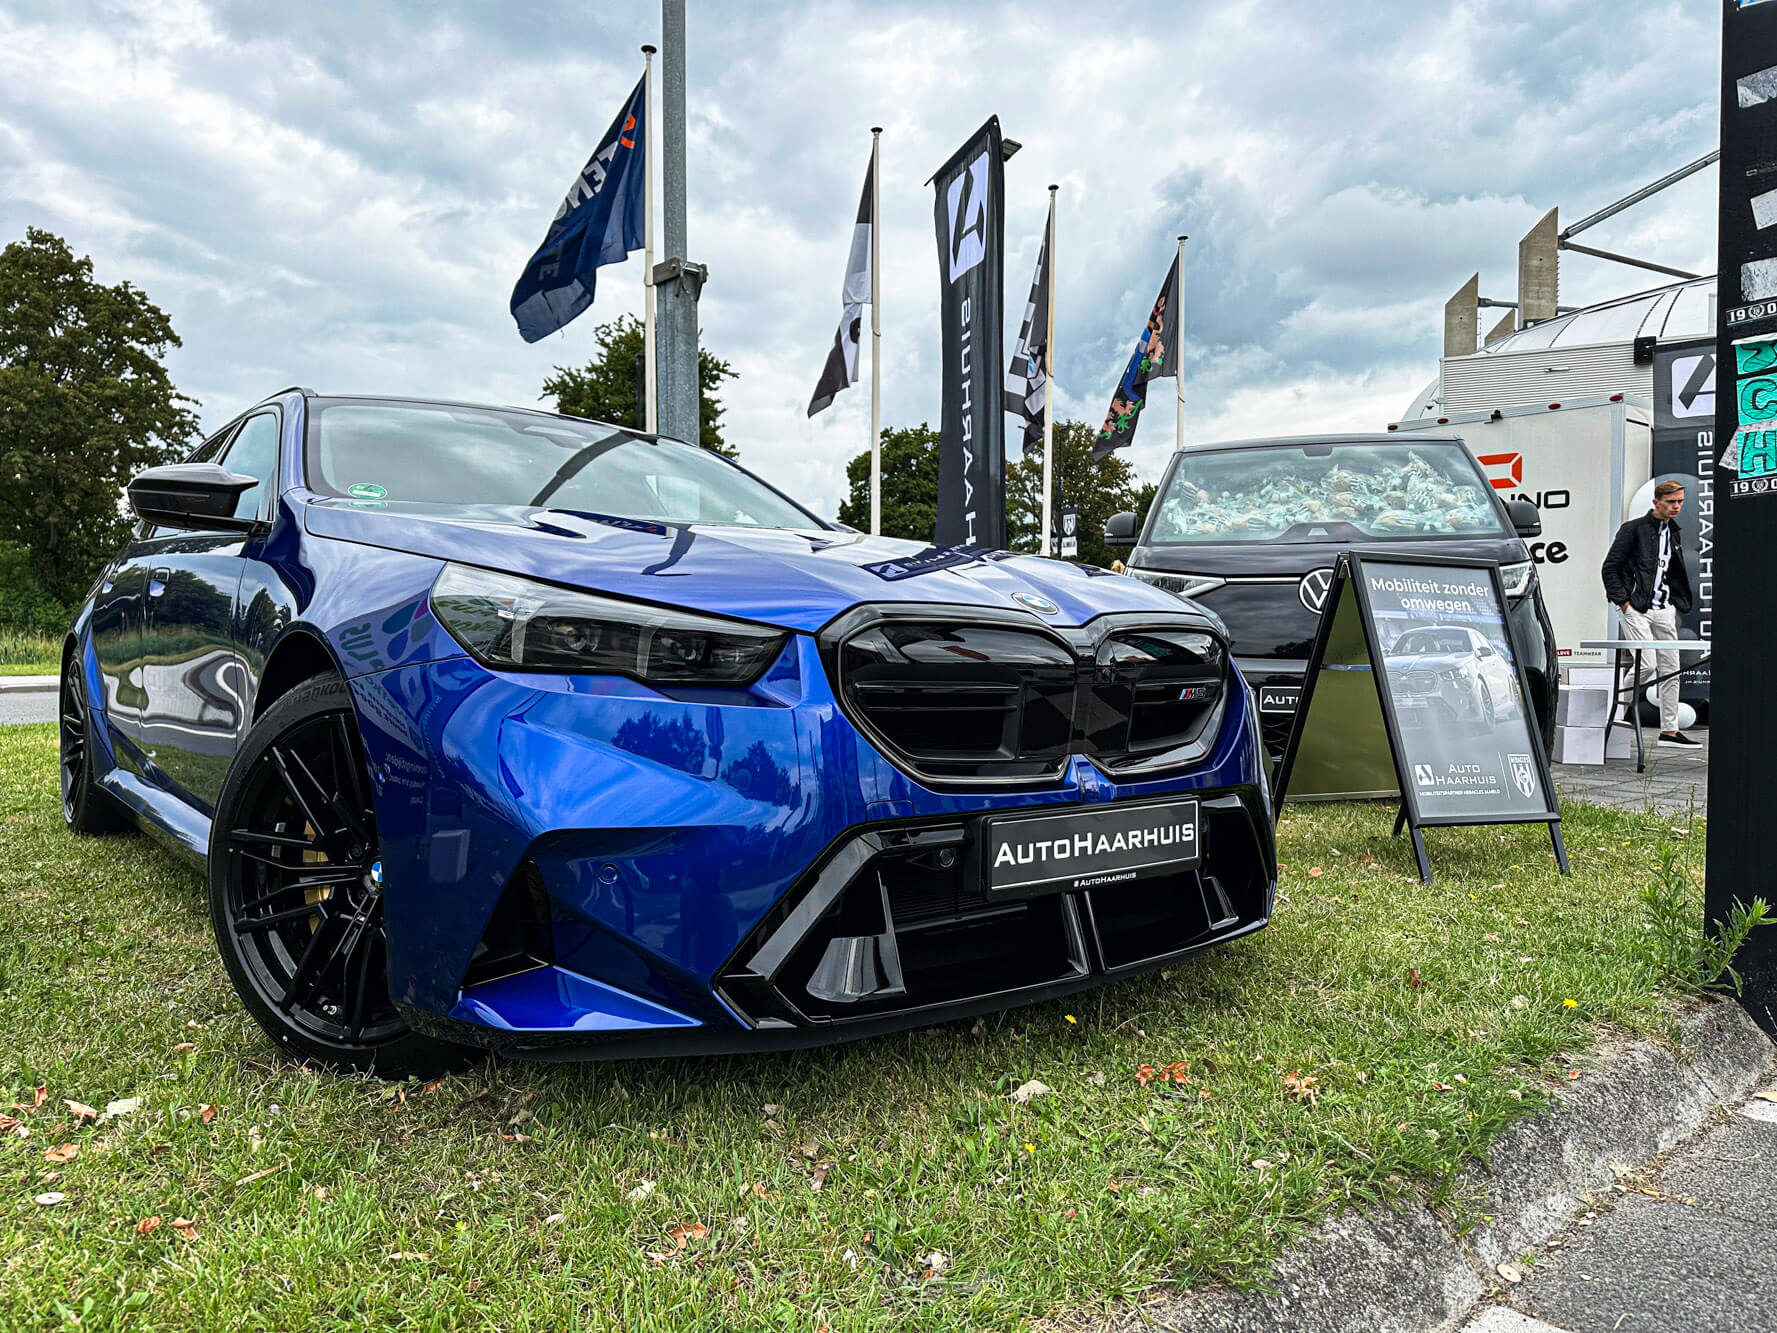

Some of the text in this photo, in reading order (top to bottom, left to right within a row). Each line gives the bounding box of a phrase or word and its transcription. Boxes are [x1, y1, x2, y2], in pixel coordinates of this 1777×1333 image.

[1529, 541, 1568, 564] ce
[1370, 577, 1489, 597] Mobiliteit zonder
[1401, 598, 1471, 613] omwegen
[1263, 694, 1298, 705] AUT
[1448, 763, 1481, 774] AUTO
[1435, 775, 1497, 785] HAARHUIS
